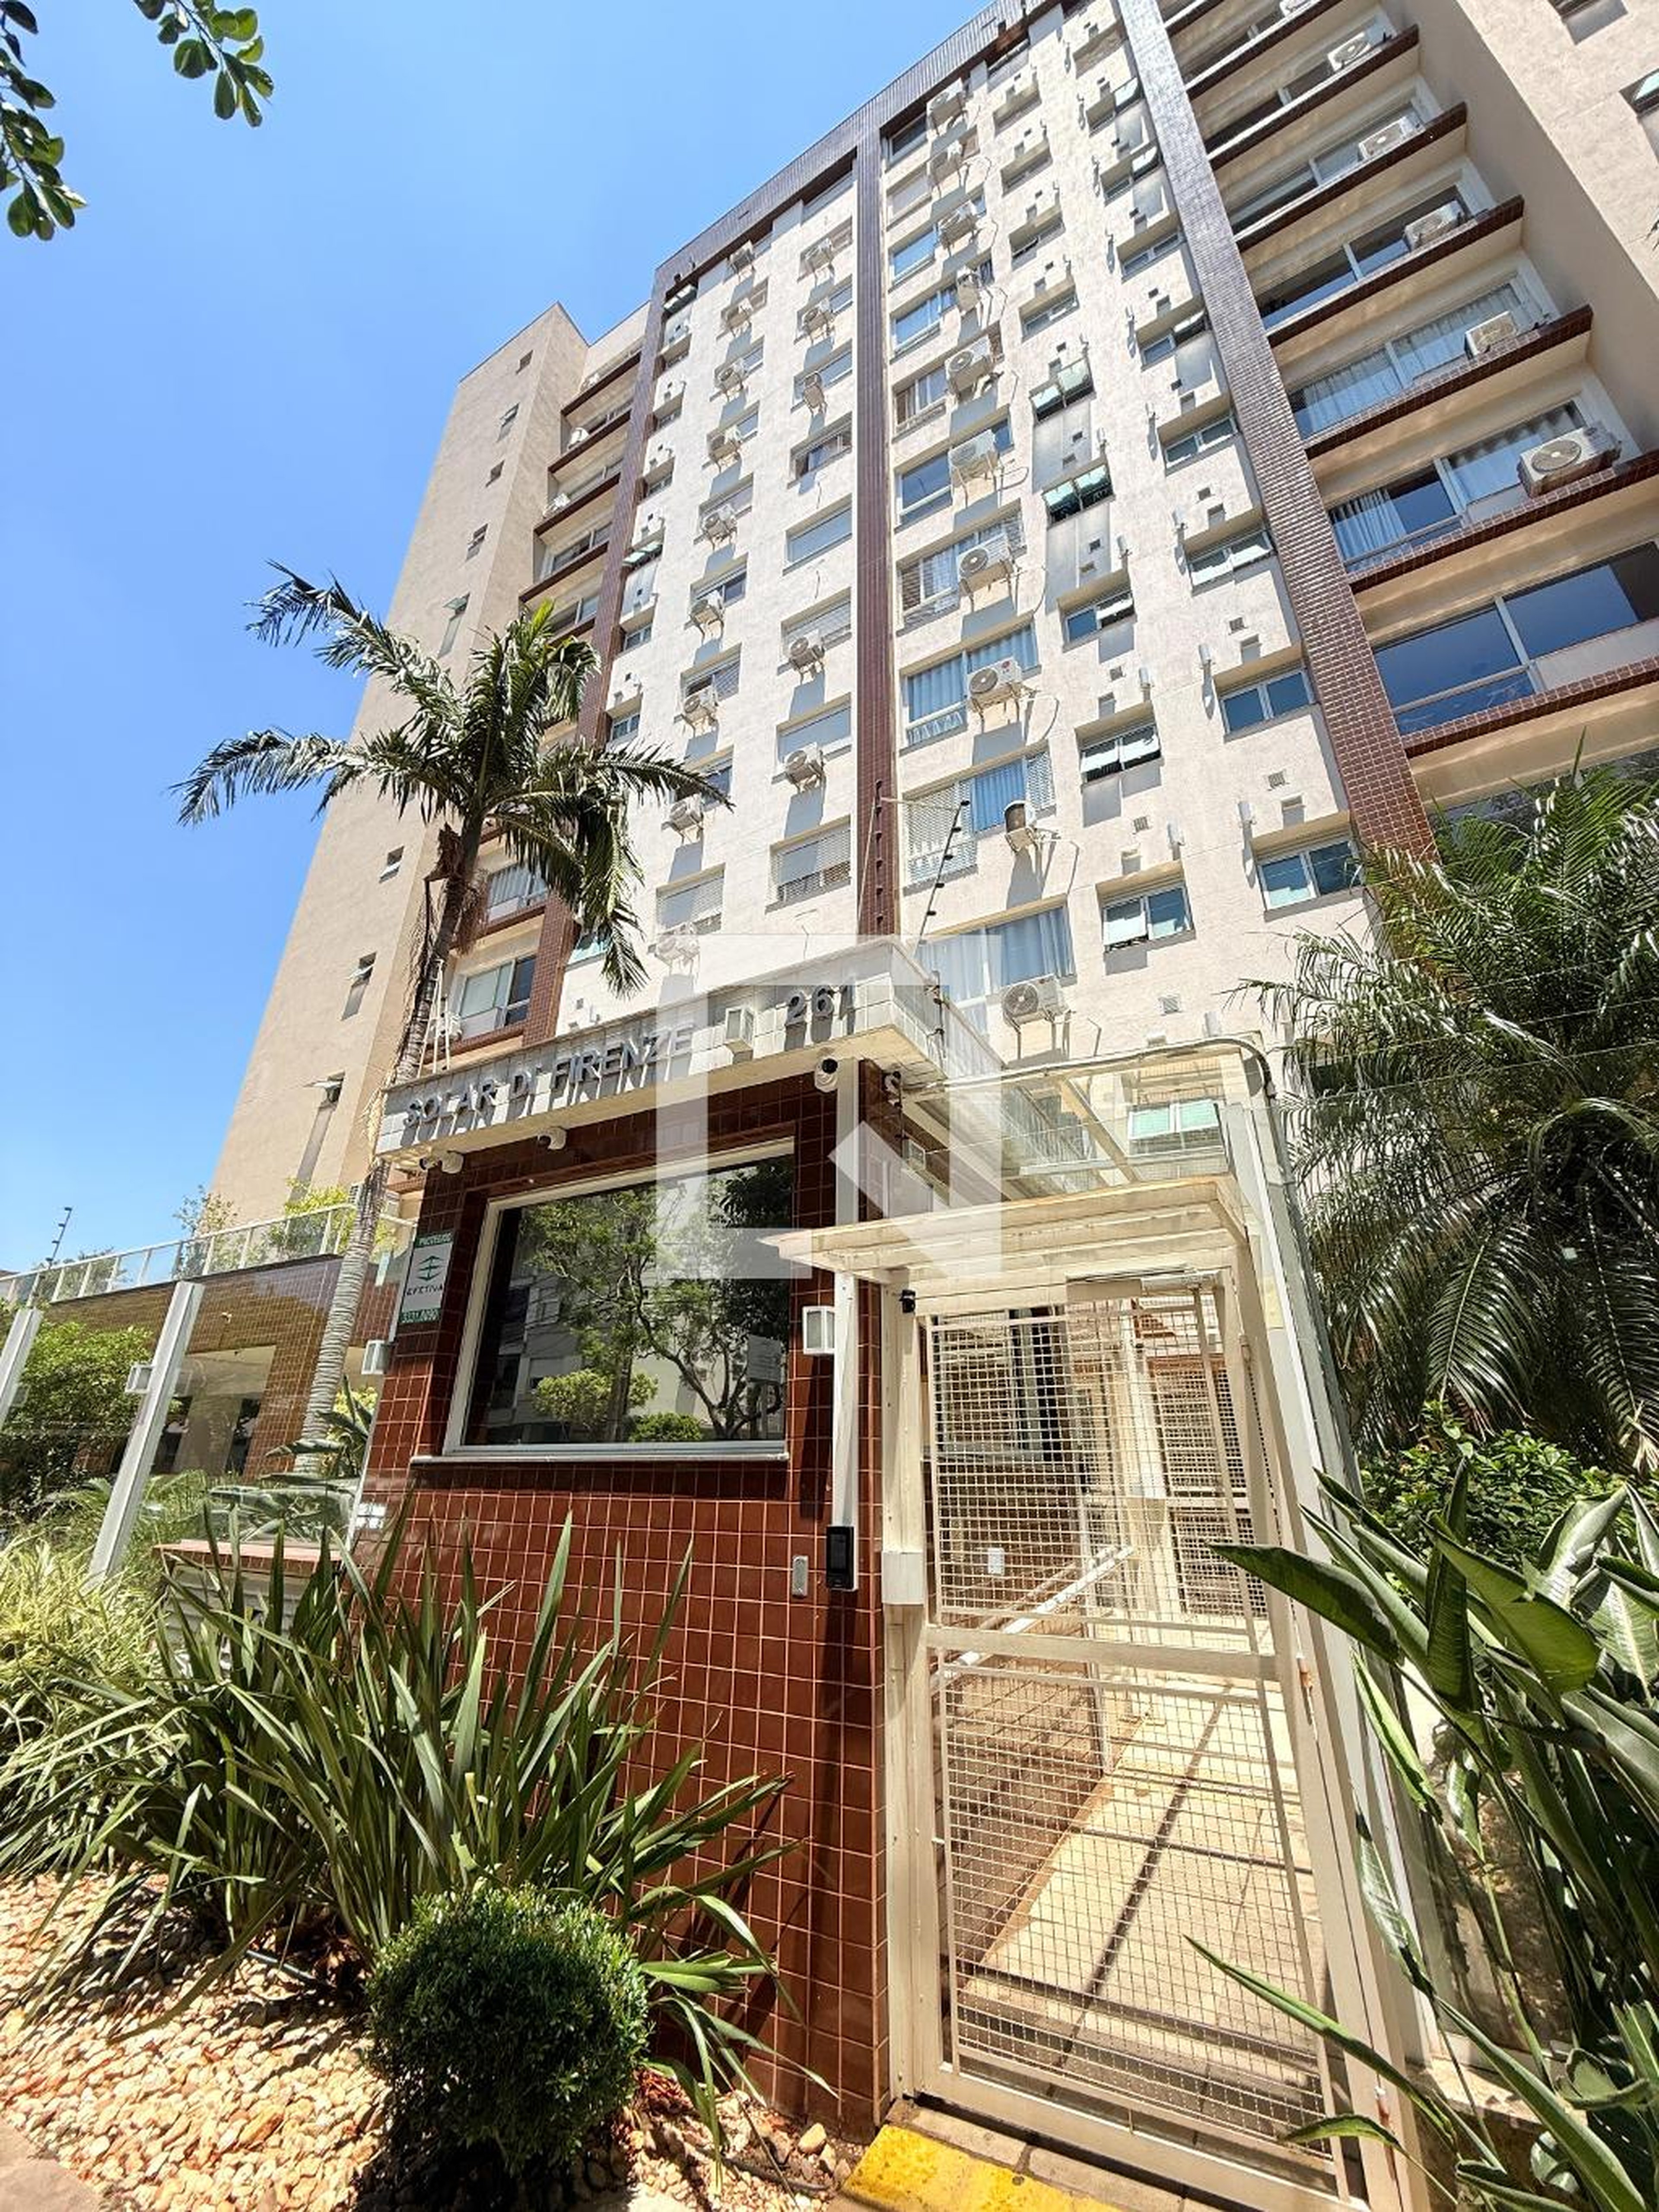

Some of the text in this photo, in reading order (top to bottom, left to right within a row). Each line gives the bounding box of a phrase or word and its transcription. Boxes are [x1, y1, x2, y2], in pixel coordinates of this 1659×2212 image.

[785, 973, 856, 1027] 261
[403, 1078, 498, 1127] SOLAR
[549, 1021, 694, 1089] FIRENZE
